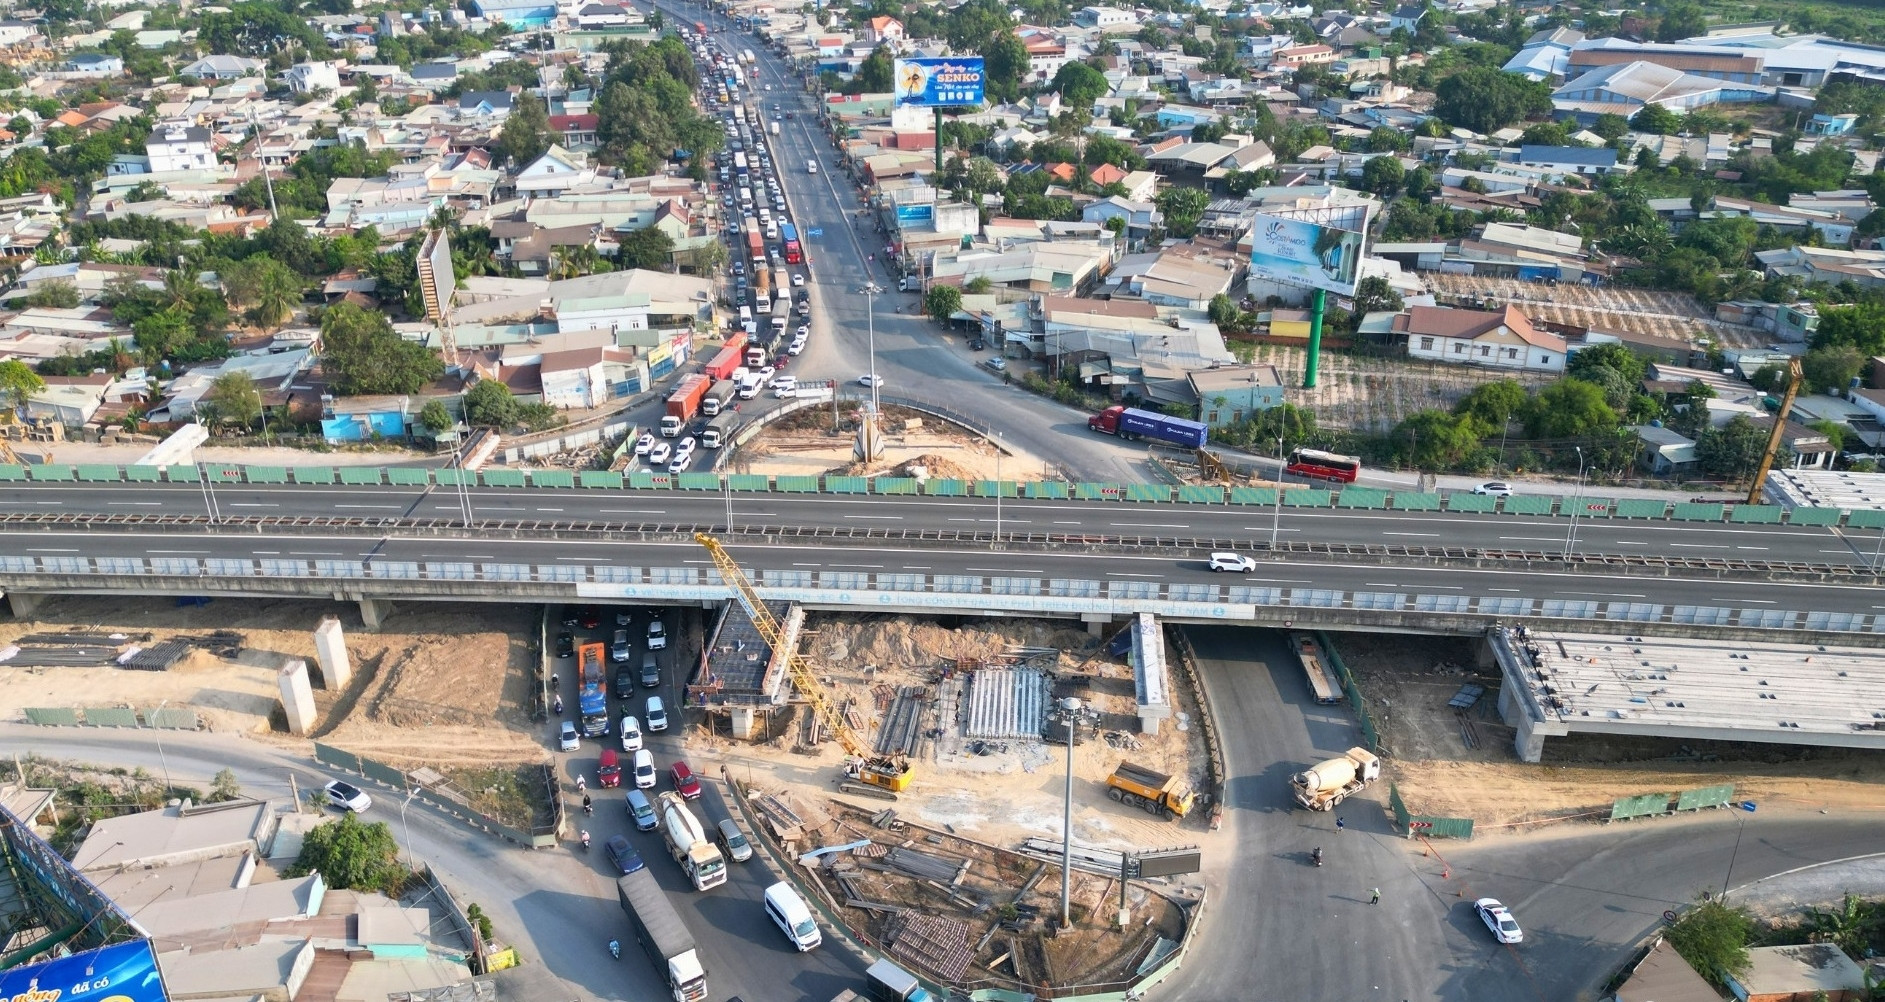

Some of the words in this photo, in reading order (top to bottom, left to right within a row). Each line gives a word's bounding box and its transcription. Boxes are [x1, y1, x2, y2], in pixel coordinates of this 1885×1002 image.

[937, 73, 980, 82] SENKO
[71, 981, 90, 995] đã
[94, 976, 109, 989] có
